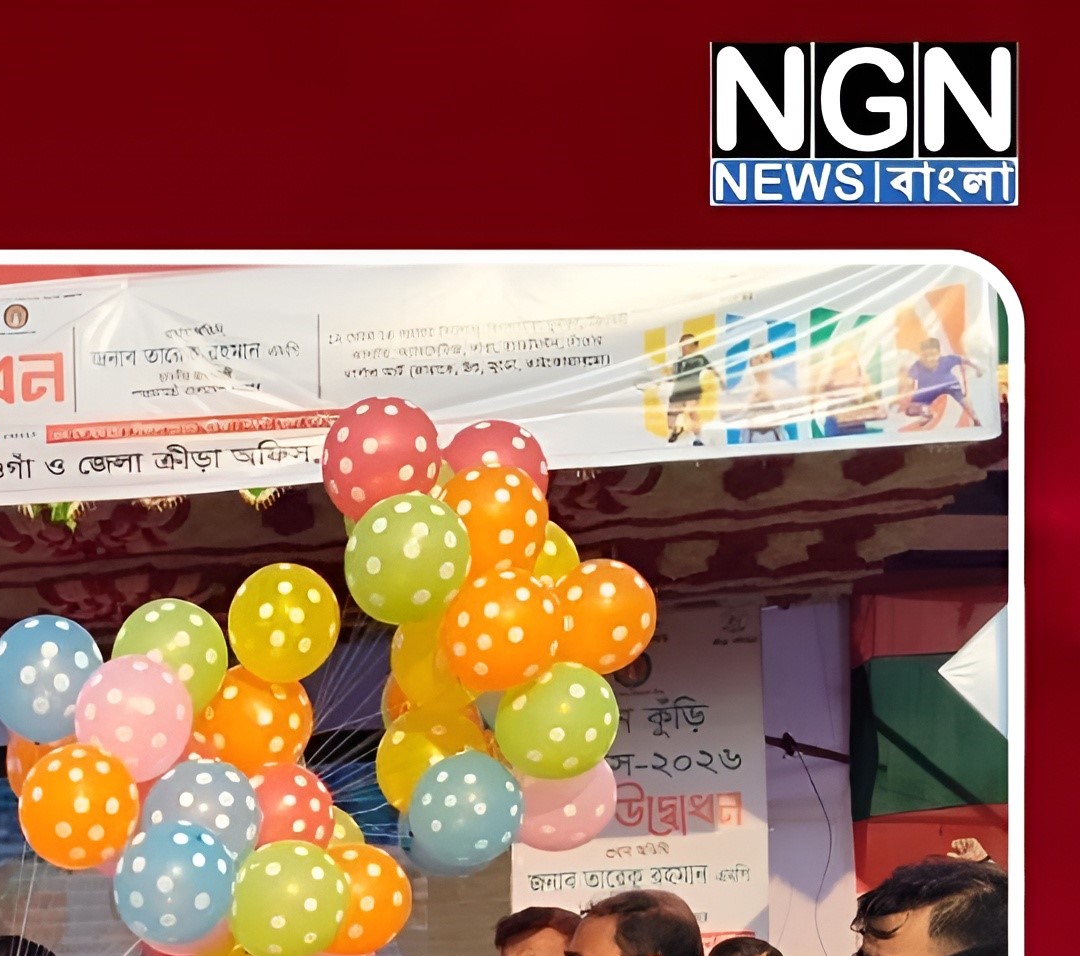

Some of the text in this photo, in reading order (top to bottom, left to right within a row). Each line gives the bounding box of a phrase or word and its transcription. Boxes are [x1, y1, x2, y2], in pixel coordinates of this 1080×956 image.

[45, 459, 67, 476] ও
[79, 453, 144, 475] জেলা
[644, 695, 710, 738] কুঁড়ি
[615, 782, 743, 836] উদ্বোধন
